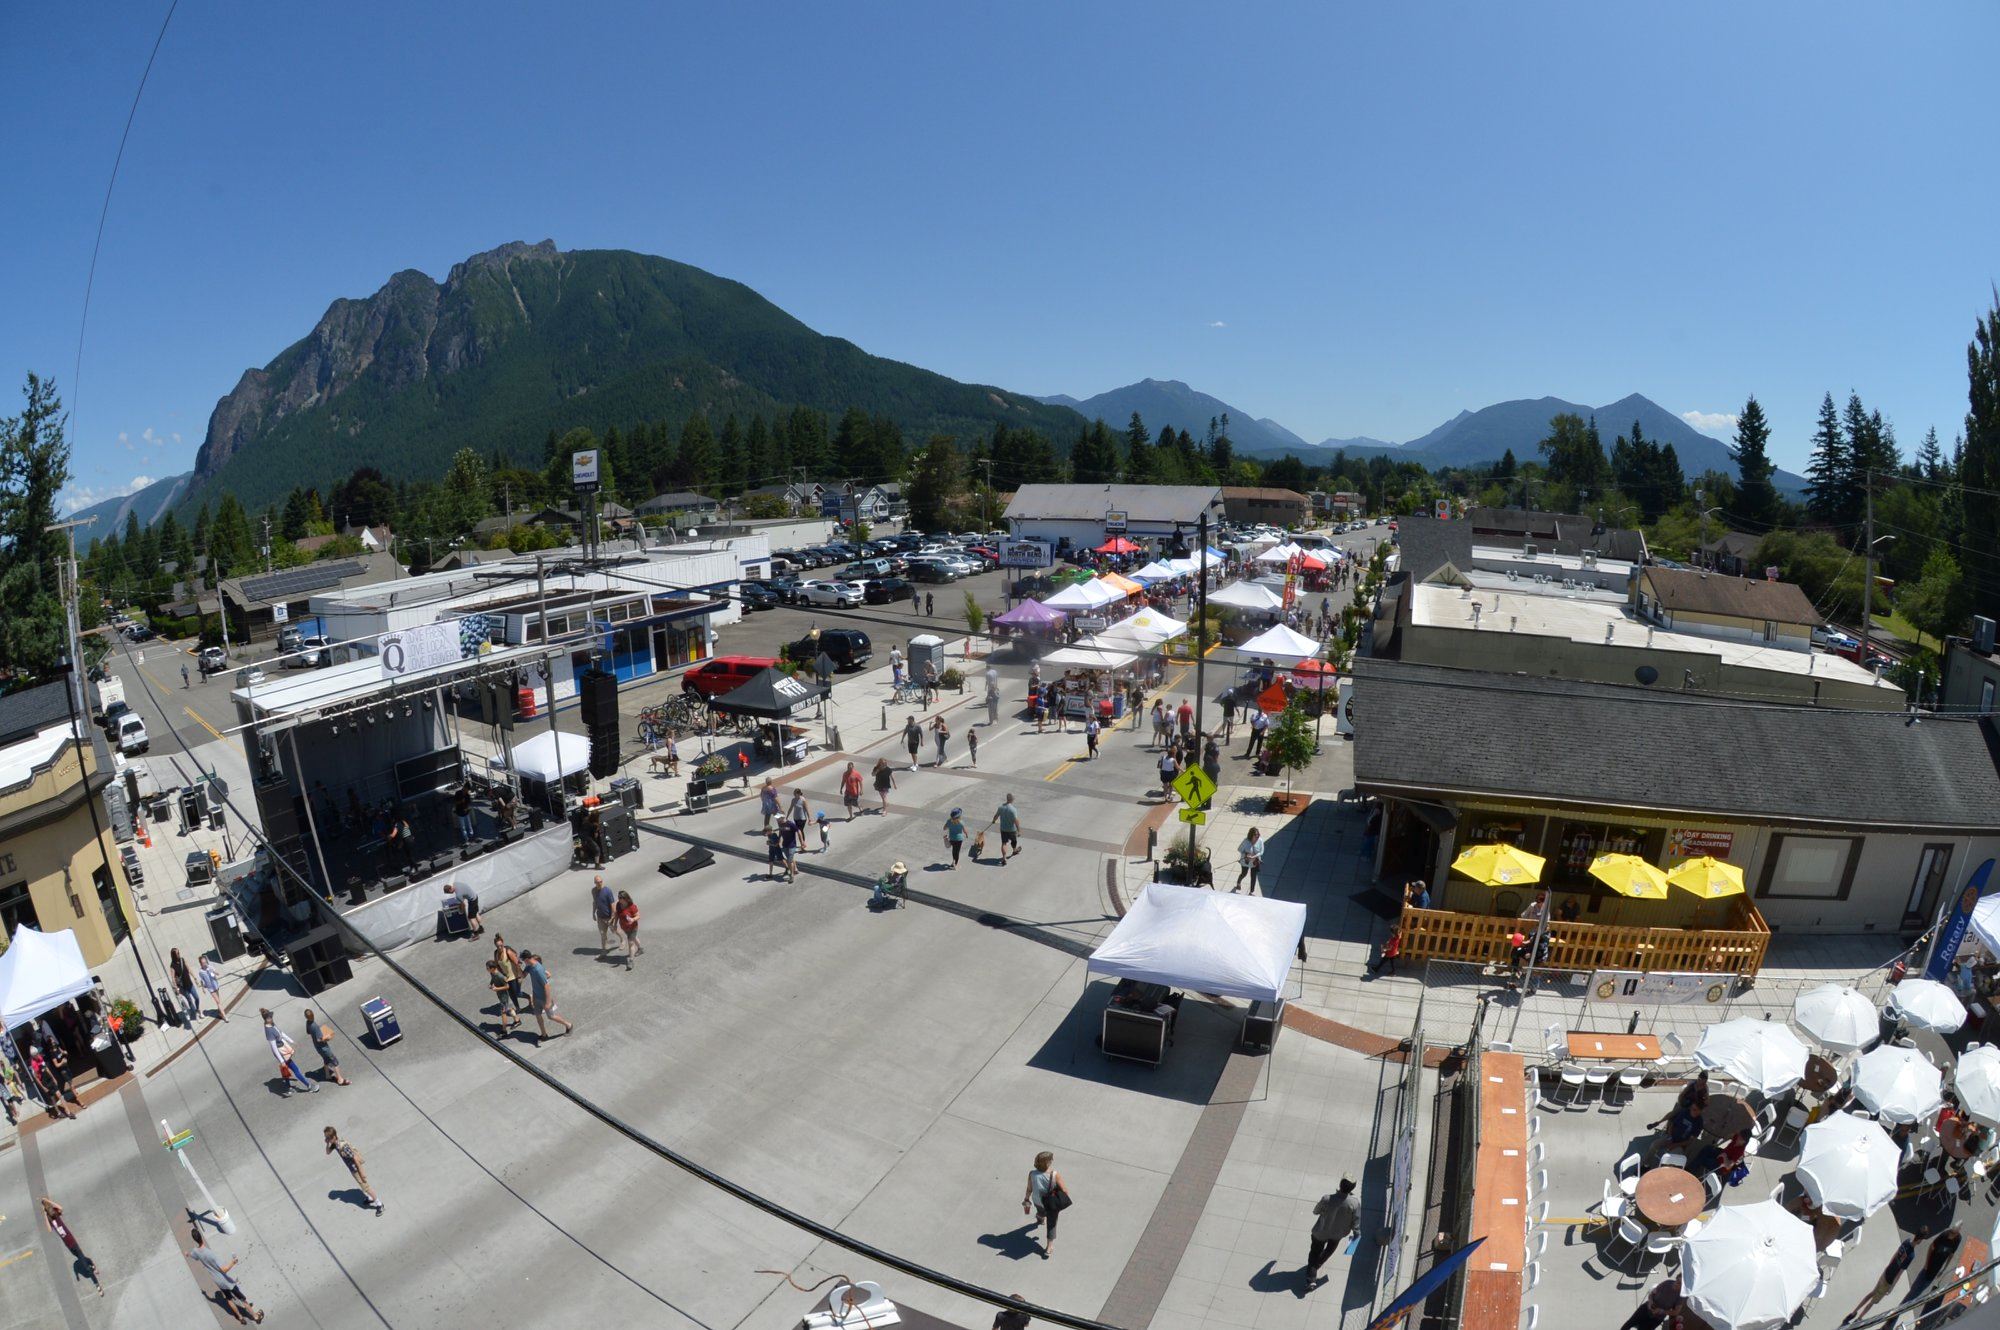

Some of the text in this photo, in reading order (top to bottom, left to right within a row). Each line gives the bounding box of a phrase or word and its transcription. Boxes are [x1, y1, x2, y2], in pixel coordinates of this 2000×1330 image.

[383, 644, 405, 673] Q
[778, 682, 808, 698] MTB
[1941, 916, 1965, 960] Rotary
